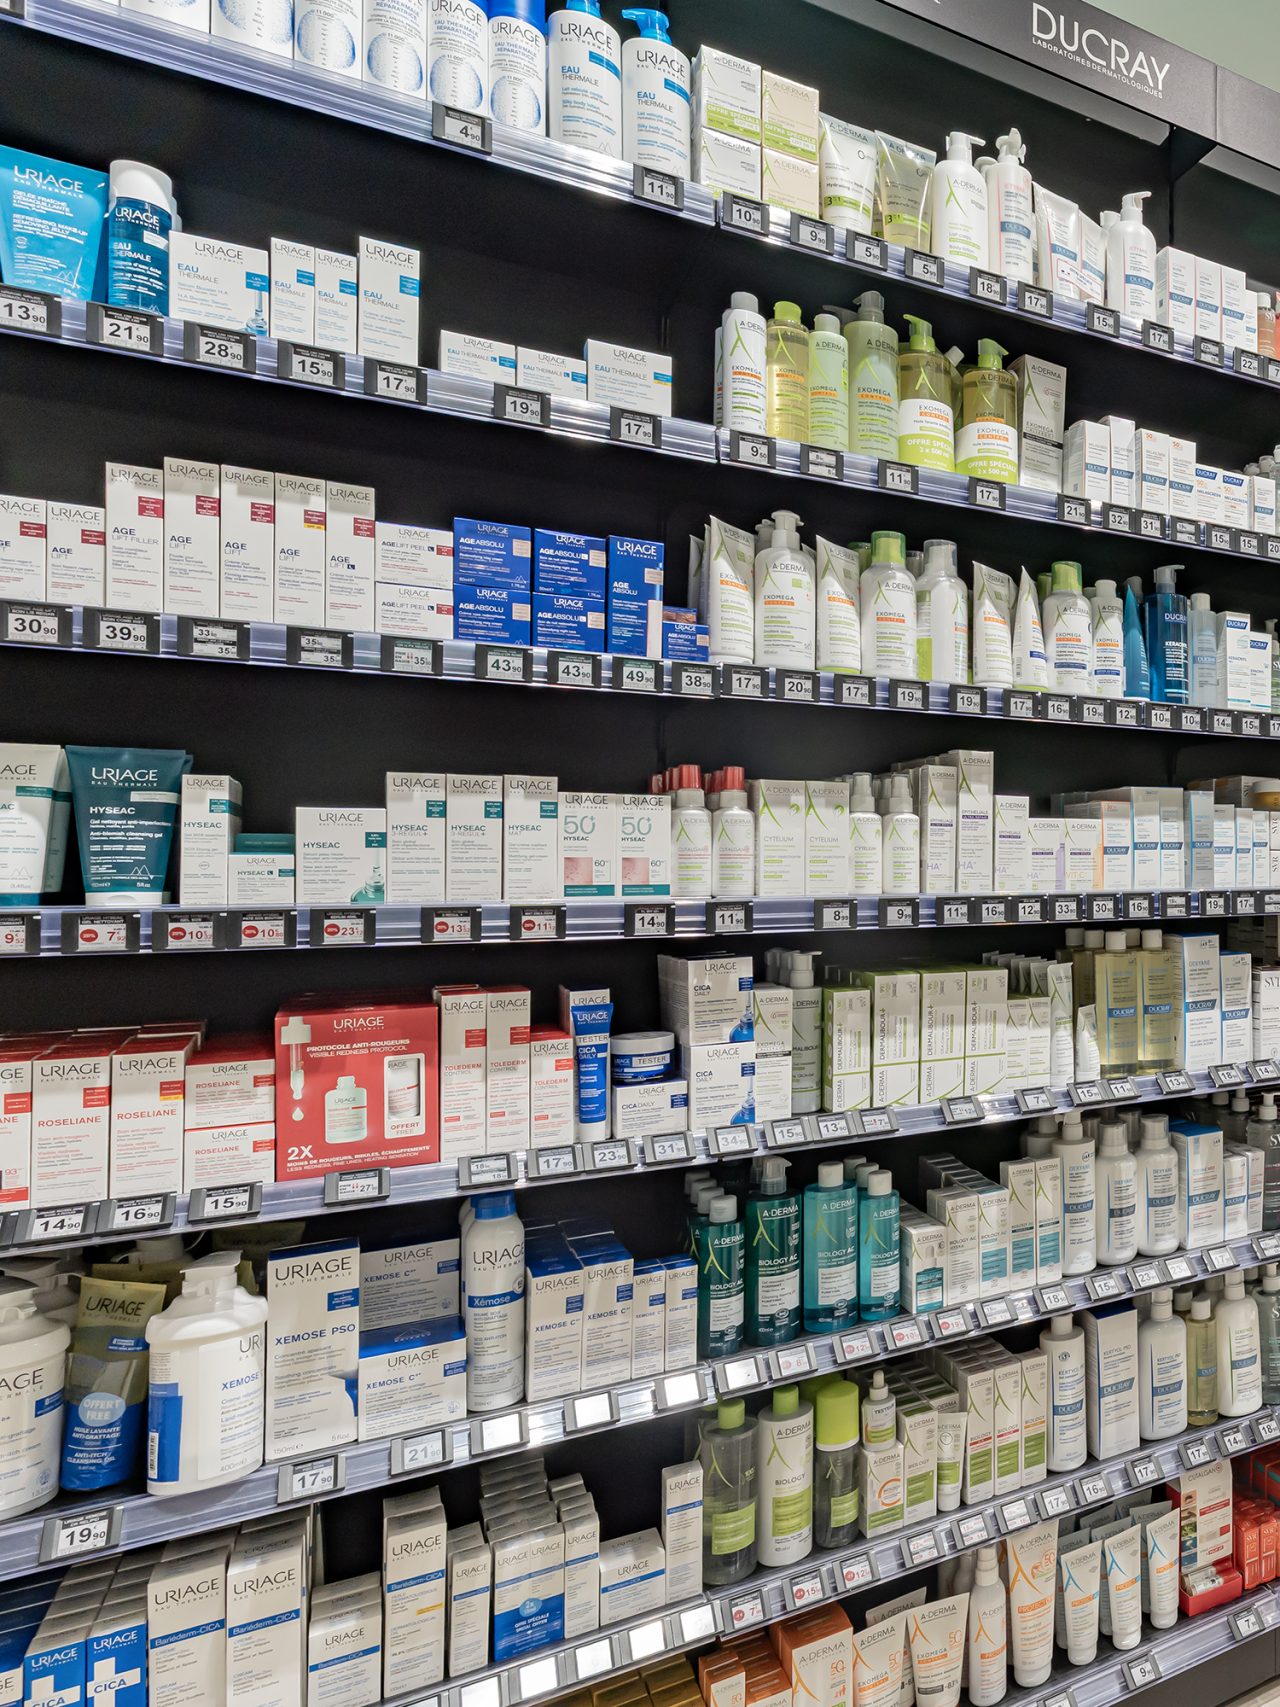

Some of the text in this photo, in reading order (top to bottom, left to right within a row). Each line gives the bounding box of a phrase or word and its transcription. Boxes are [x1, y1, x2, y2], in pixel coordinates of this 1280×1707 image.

[431, 0, 482, 26] URIAGE
[491, 22, 541, 47] URIAGE
[560, 23, 612, 50] URIAGE
[1033, 2, 1170, 90] DUCRAY
[637, 50, 686, 77] URIAGE
[1032, 36, 1163, 99] LABORATOIRES DERMATOLOGIQUES
[561, 66, 580, 75] EAU
[561, 73, 599, 87] THERMALE
[637, 91, 655, 100] EAU
[637, 99, 673, 112] THERMALE
[13, 165, 84, 193] URIAGE
[115, 207, 160, 227] URIAGE
[113, 242, 131, 251] EAU
[195, 241, 244, 261] URIAGE
[366, 243, 415, 265] URIAGE
[177, 263, 199, 275] EAU
[178, 270, 219, 284] THERMALE
[363, 288, 383, 300] EAU
[363, 297, 400, 311] THERMALE
[614, 349, 647, 364] URIAGE
[594, 363, 647, 381] EAU THERMALE
[731, 365, 762, 375] EXOMEGA
[857, 387, 891, 398] EXOMEGA
[977, 427, 1008, 436] EXOMEGA
[111, 468, 159, 484] URIAGE
[225, 471, 270, 486] URIAGE
[1195, 469, 1217, 480] DUCRAY
[51, 506, 100, 522] URIAGE
[112, 527, 136, 536] AGE
[476, 523, 509, 536] URIAGE
[112, 534, 159, 545] LIFT FILLER
[51, 546, 73, 556] AGE
[225, 542, 247, 551] AGE
[617, 541, 657, 556] URIAGE
[612, 588, 637, 596] ABSOLU
[613, 582, 629, 590] AGE
[1226, 620, 1248, 630] DUCRAY
[91, 767, 158, 783] URIAGE
[392, 777, 440, 791] URIAGE
[90, 807, 136, 815] HYSEAC
[318, 812, 364, 825] URIAGE
[391, 824, 428, 832] HYSEAC
[303, 841, 341, 849] HYSEAC
[1107, 847, 1128, 855] DUCRAY
[1189, 1000, 1215, 1012] DUCRAY
[333, 1016, 384, 1030] URIAGE
[307, 1039, 410, 1052] PROTOCOLE ANTI-ROUGEURS
[578, 1034, 609, 1044] TESTER
[309, 1045, 407, 1058] VISIBLE REDNESS PROTOCOL
[578, 1046, 596, 1055] CICA
[119, 1057, 177, 1073] URIAGE
[637, 1055, 667, 1065] TESTER
[40, 1062, 101, 1078] URIAGE
[444, 1063, 482, 1072] TOLEDERM
[444, 1069, 473, 1077] CONTROL
[38, 1115, 102, 1127] ROSELIANE
[117, 1108, 177, 1121] ROSELIANE
[391, 1122, 420, 1130] OFFERT
[287, 1145, 313, 1160] 2X
[759, 1257, 784, 1266] BIOLOGY
[275, 1255, 352, 1282] URIAGE
[536, 1275, 580, 1292] URIAGE
[473, 1293, 511, 1307] Xémose
[275, 1323, 356, 1347] XEMOSE PSO
[1104, 1380, 1134, 1396] DUCRAY
[83, 1398, 120, 1409] OFFERT
[86, 1410, 112, 1420] FREE
[775, 1473, 805, 1485] BIOLOGY
[391, 1534, 442, 1557] URIAGE
[234, 1568, 296, 1595] URIAGE
[155, 1577, 219, 1605] URIAGE
[155, 1622, 221, 1647] Bariéderm-CICA
[917, 1648, 948, 1659] EXOMEGA
[94, 1678, 127, 1694] CICA
